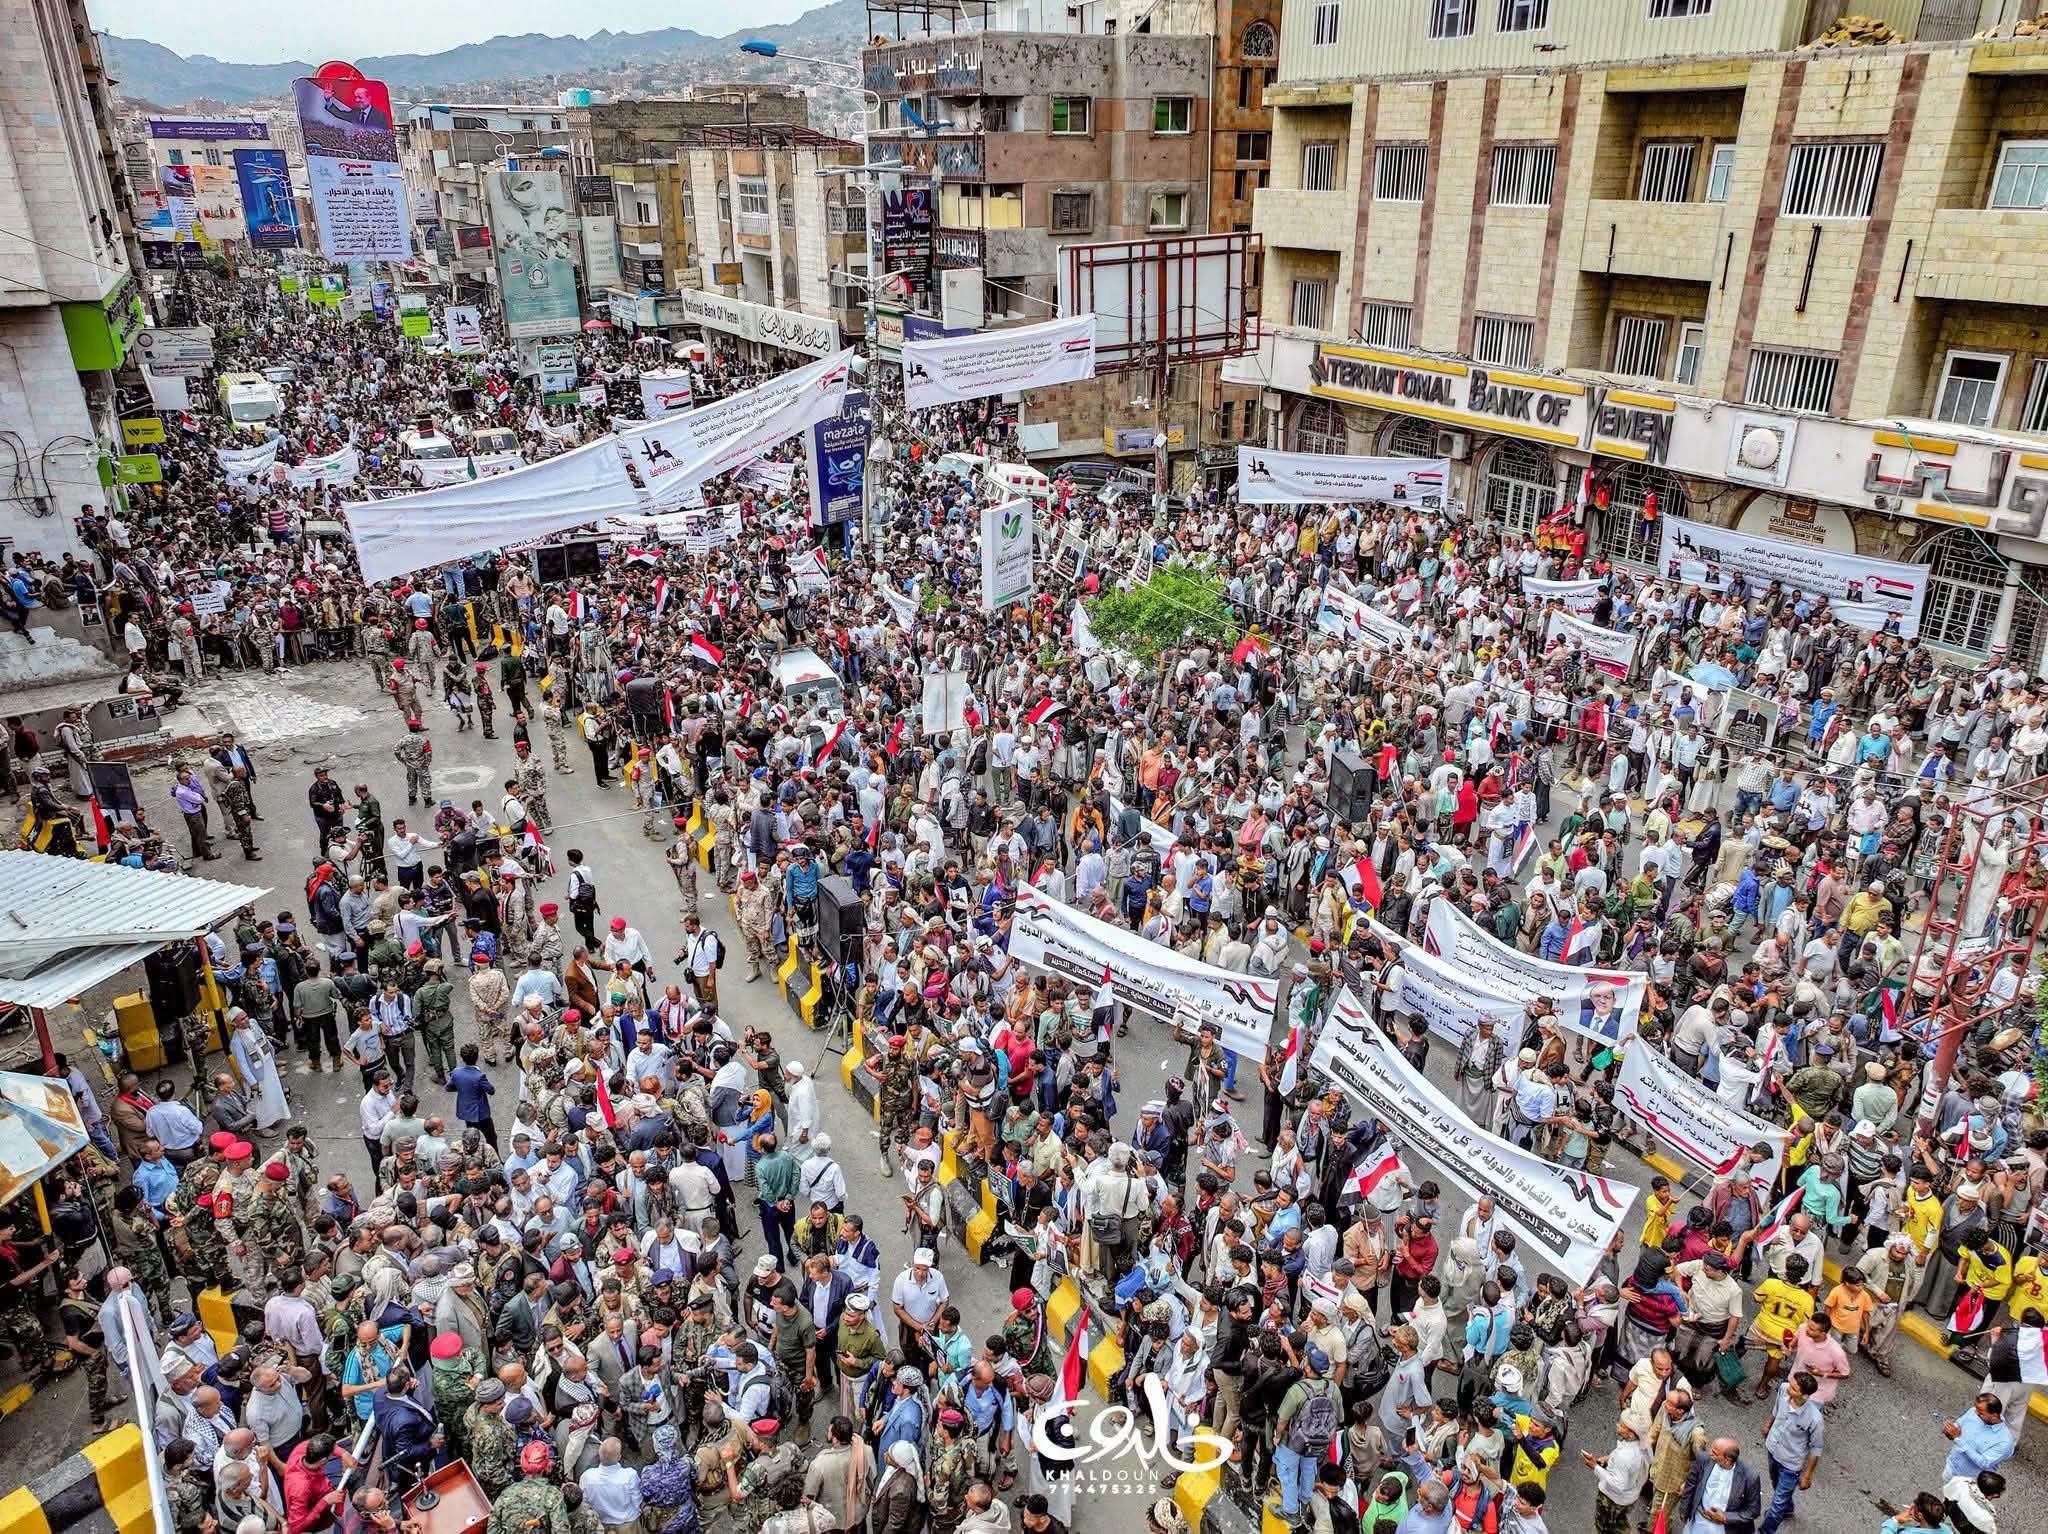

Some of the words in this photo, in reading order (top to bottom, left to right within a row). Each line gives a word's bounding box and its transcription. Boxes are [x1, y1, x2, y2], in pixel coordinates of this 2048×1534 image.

[704, 302, 717, 318] Bank
[1309, 356, 1456, 407] INTERNATIONAL
[1467, 369, 1535, 423] BANK
[1536, 393, 1571, 426] OF
[1585, 386, 1673, 465] YEMEN
[1018, 923, 1042, 940] الدولة
[1331, 1031, 1371, 1065] الوطنية
[1369, 1061, 1406, 1094] السيادة
[1452, 1134, 1473, 1148] كل
[1467, 1145, 1484, 1159] في
[1482, 1152, 1516, 1184] والدولة
[1516, 1176, 1553, 1207] القيادة
[1548, 1204, 1567, 1220] مع
[1774, 1301, 1798, 1319] 17
